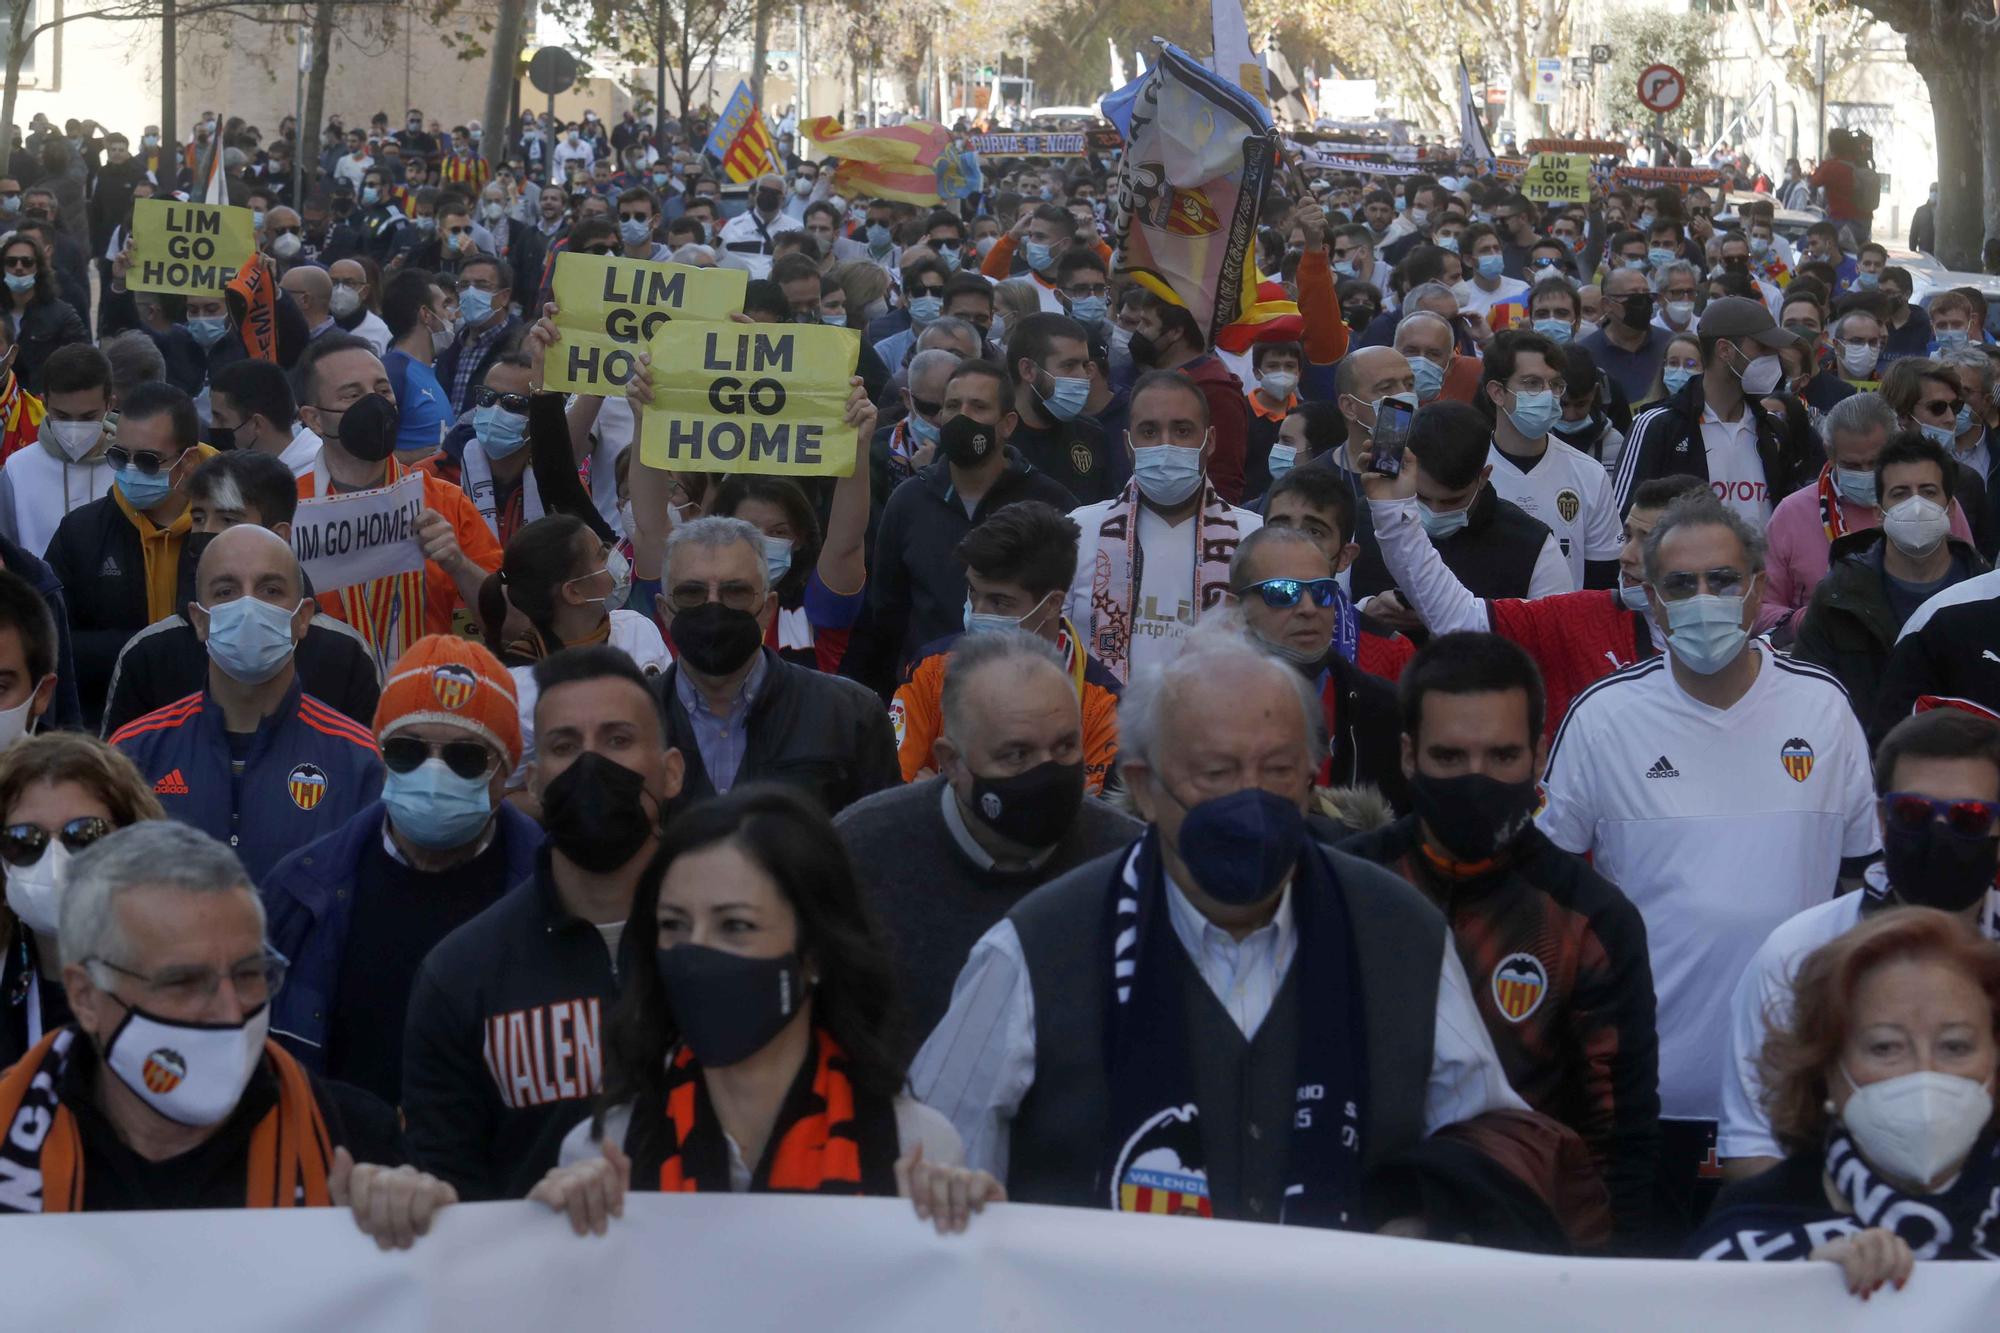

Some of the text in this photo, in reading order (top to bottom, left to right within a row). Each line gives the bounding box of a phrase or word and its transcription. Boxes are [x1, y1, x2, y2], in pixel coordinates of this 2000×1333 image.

[1541, 157, 1570, 170] LIM
[1542, 171, 1567, 183] GO
[1530, 184, 1580, 199] HOME
[166, 208, 221, 235] LIM
[168, 236, 215, 261] GO
[143, 261, 236, 290] HOME
[603, 266, 686, 308] LIM
[704, 332, 794, 373] LIM
[708, 376, 786, 415] GO
[668, 420, 824, 464] HOME
[296, 523, 320, 562] IM
[325, 520, 351, 557] GO
[1646, 769, 1680, 779] adidas
[153, 783, 189, 794] adidas
